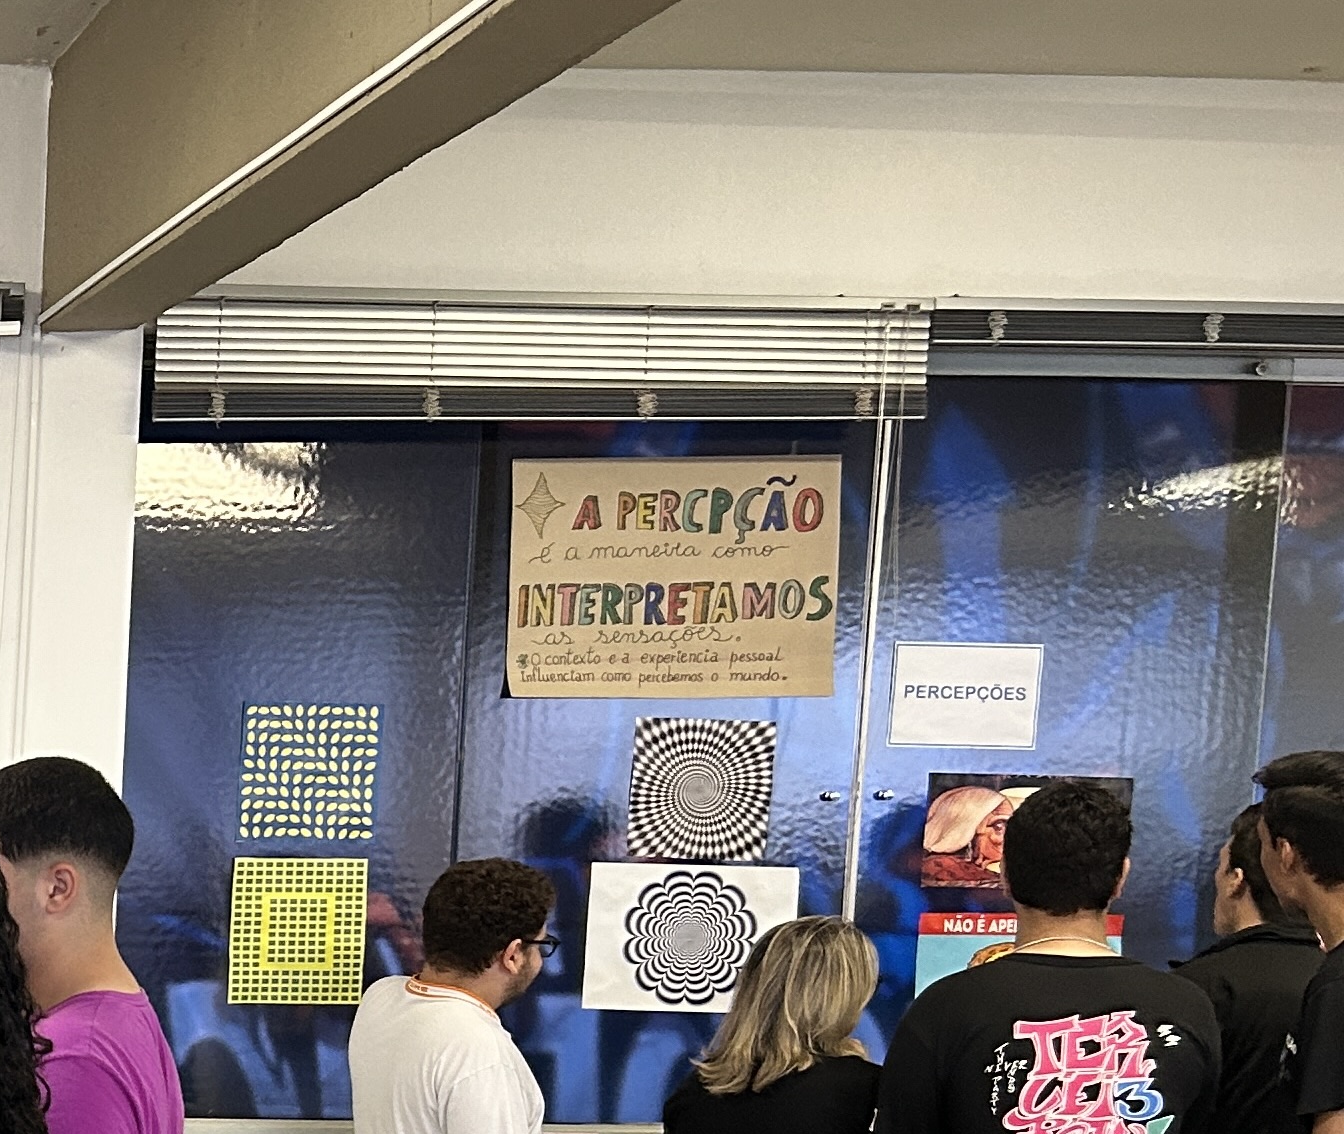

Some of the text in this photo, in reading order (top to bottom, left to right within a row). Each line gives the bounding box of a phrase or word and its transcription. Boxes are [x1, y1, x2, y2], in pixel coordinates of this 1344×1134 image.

[572, 474, 824, 545] A PERCPÇÃO
[564, 546, 580, 561] a
[711, 544, 790, 559] como
[517, 575, 833, 628] INTERPRETAMOS
[532, 629, 575, 646] as
[544, 649, 601, 665] contexto
[608, 654, 616, 664] e
[621, 653, 630, 664] a
[601, 670, 632, 682] como
[711, 672, 719, 682] o
[903, 682, 1027, 703] PERCEPÇÕES
[944, 914, 974, 933] NÃO
[976, 914, 986, 933] É
